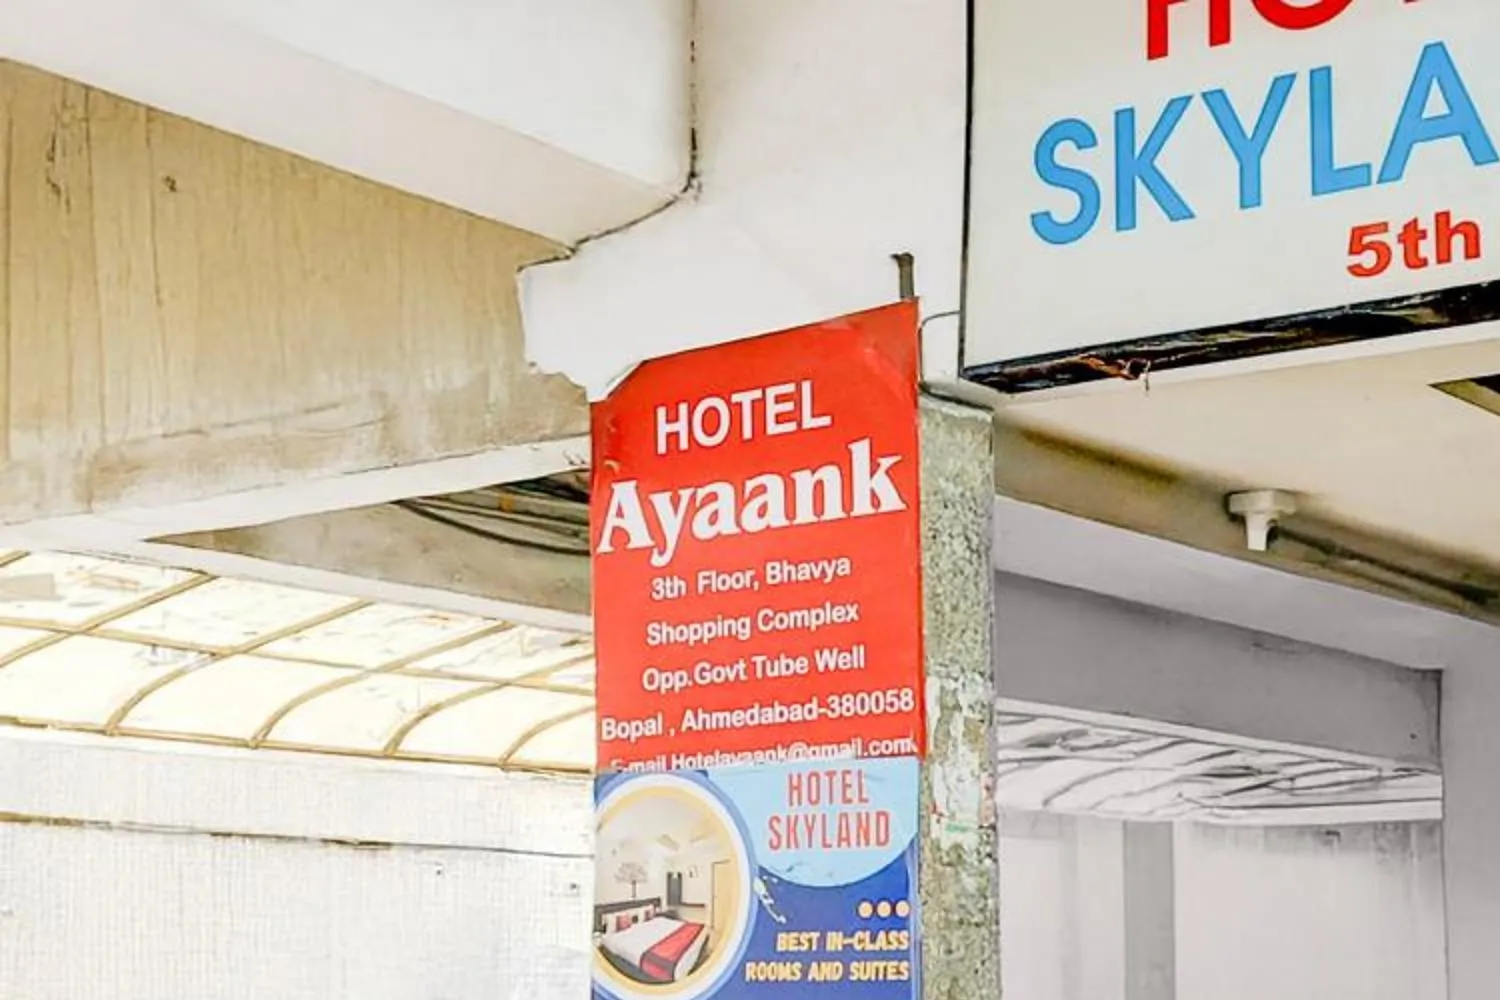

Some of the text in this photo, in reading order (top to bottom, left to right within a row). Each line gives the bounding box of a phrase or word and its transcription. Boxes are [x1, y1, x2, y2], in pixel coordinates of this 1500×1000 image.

[1346, 210, 1481, 278] 5th
[656, 380, 832, 454] HOTEL
[598, 437, 907, 567] Ayaank
[651, 556, 851, 600] 3th Floor, Bhavya
[646, 601, 860, 646] Shopping Complex
[752, 654, 809, 678] Tube
[815, 645, 865, 673] Well
[601, 713, 663, 743] Bopal
[680, 687, 915, 733] Ahmedabad-380058
[788, 769, 869, 807] HOTEL
[768, 810, 890, 852] SKYLAND
[776, 929, 909, 952] BEST IN-CLASS
[745, 960, 909, 982] ROOMS AND SUITES
